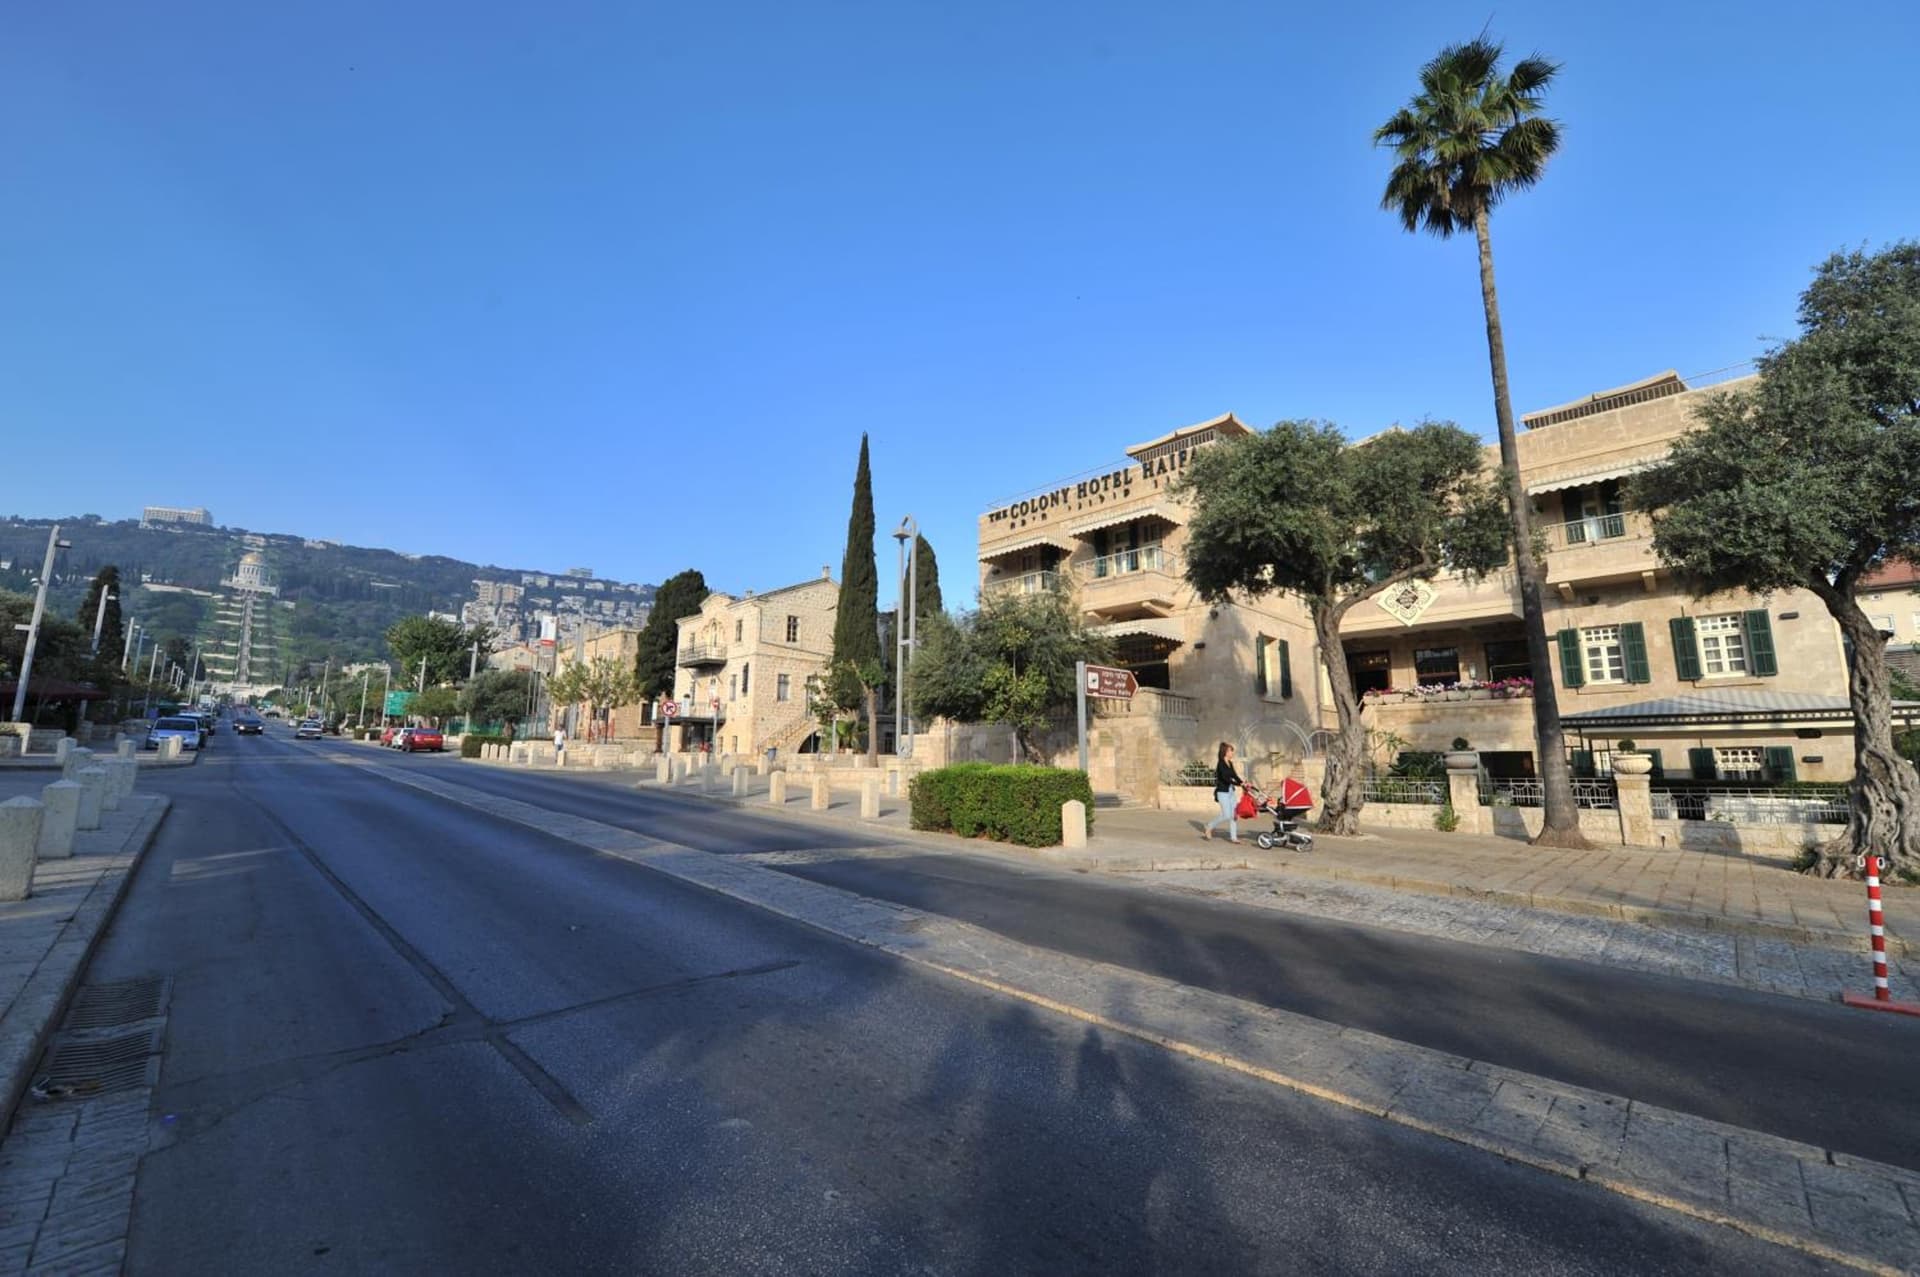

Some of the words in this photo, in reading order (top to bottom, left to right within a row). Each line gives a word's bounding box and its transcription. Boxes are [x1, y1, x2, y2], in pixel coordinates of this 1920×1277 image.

[988, 509, 1008, 523] THE
[1010, 487, 1070, 519] COLONY
[1077, 468, 1133, 499] HOTEL
